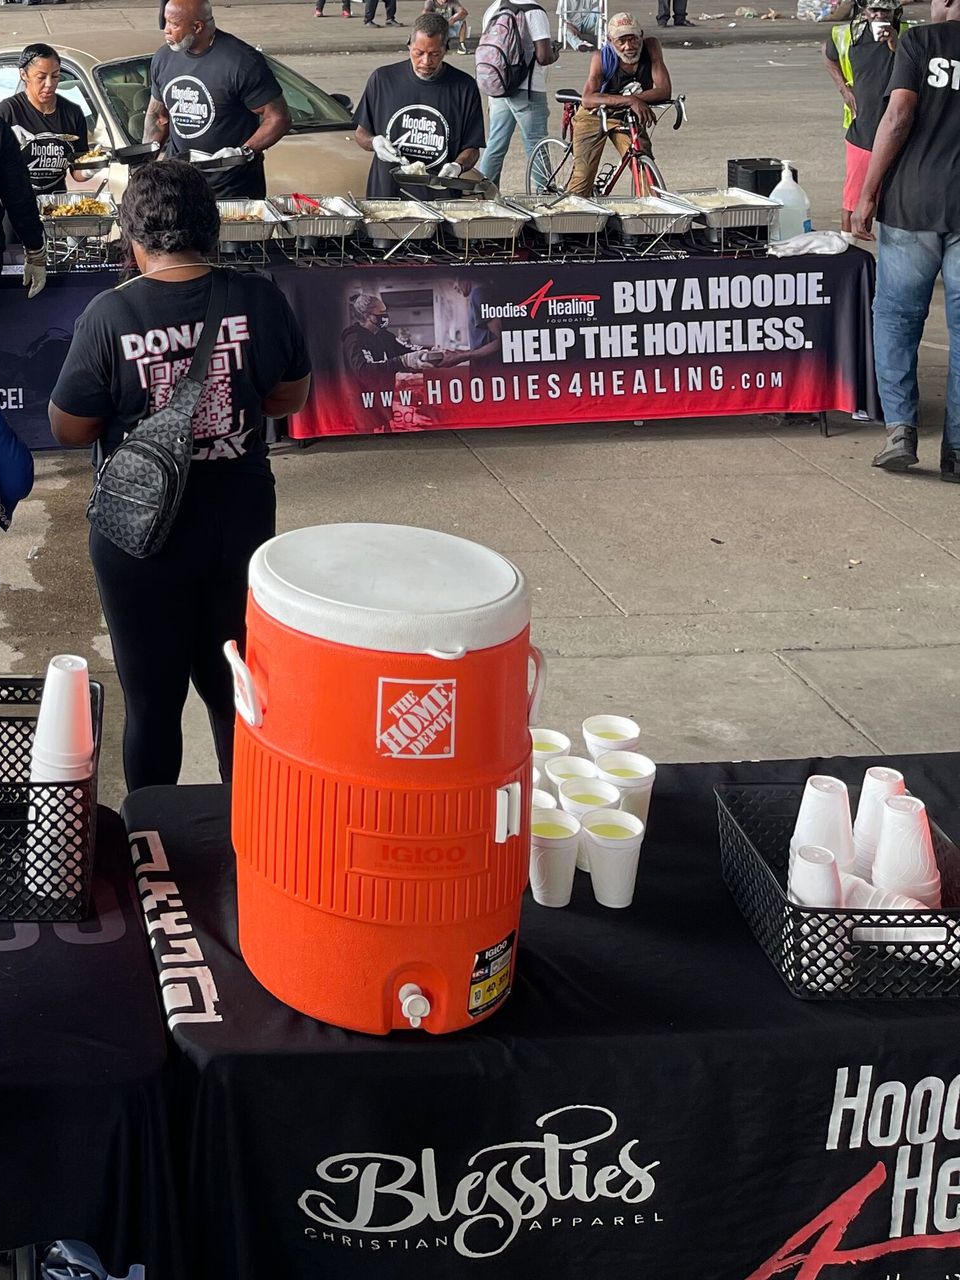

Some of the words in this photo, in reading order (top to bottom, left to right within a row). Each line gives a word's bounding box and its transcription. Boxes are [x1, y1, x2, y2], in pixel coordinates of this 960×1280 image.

[402, 114, 437, 134] Hoodies
[31, 142, 65, 158] Hoodies
[410, 128, 445, 151] Healing
[38, 155, 69, 169] Healin
[613, 278, 678, 314] BUY
[681, 277, 704, 311] A
[708, 271, 831, 310] HOODIE.
[481, 302, 528, 319] Hoodies
[548, 298, 595, 317] Healing
[501, 327, 576, 363] HELP
[579, 323, 639, 360] THE
[643, 316, 813, 357] HOMELESS.
[387, 690, 419, 719] THE
[381, 685, 452, 754] HOME
[408, 708, 452, 755] DEPOT
[381, 843, 467, 864] IGLOO
[485, 940, 508, 960] IGLOO
[304, 1227, 449, 1251] CHRISTIAN
[529, 1212, 664, 1231] APPAREL
